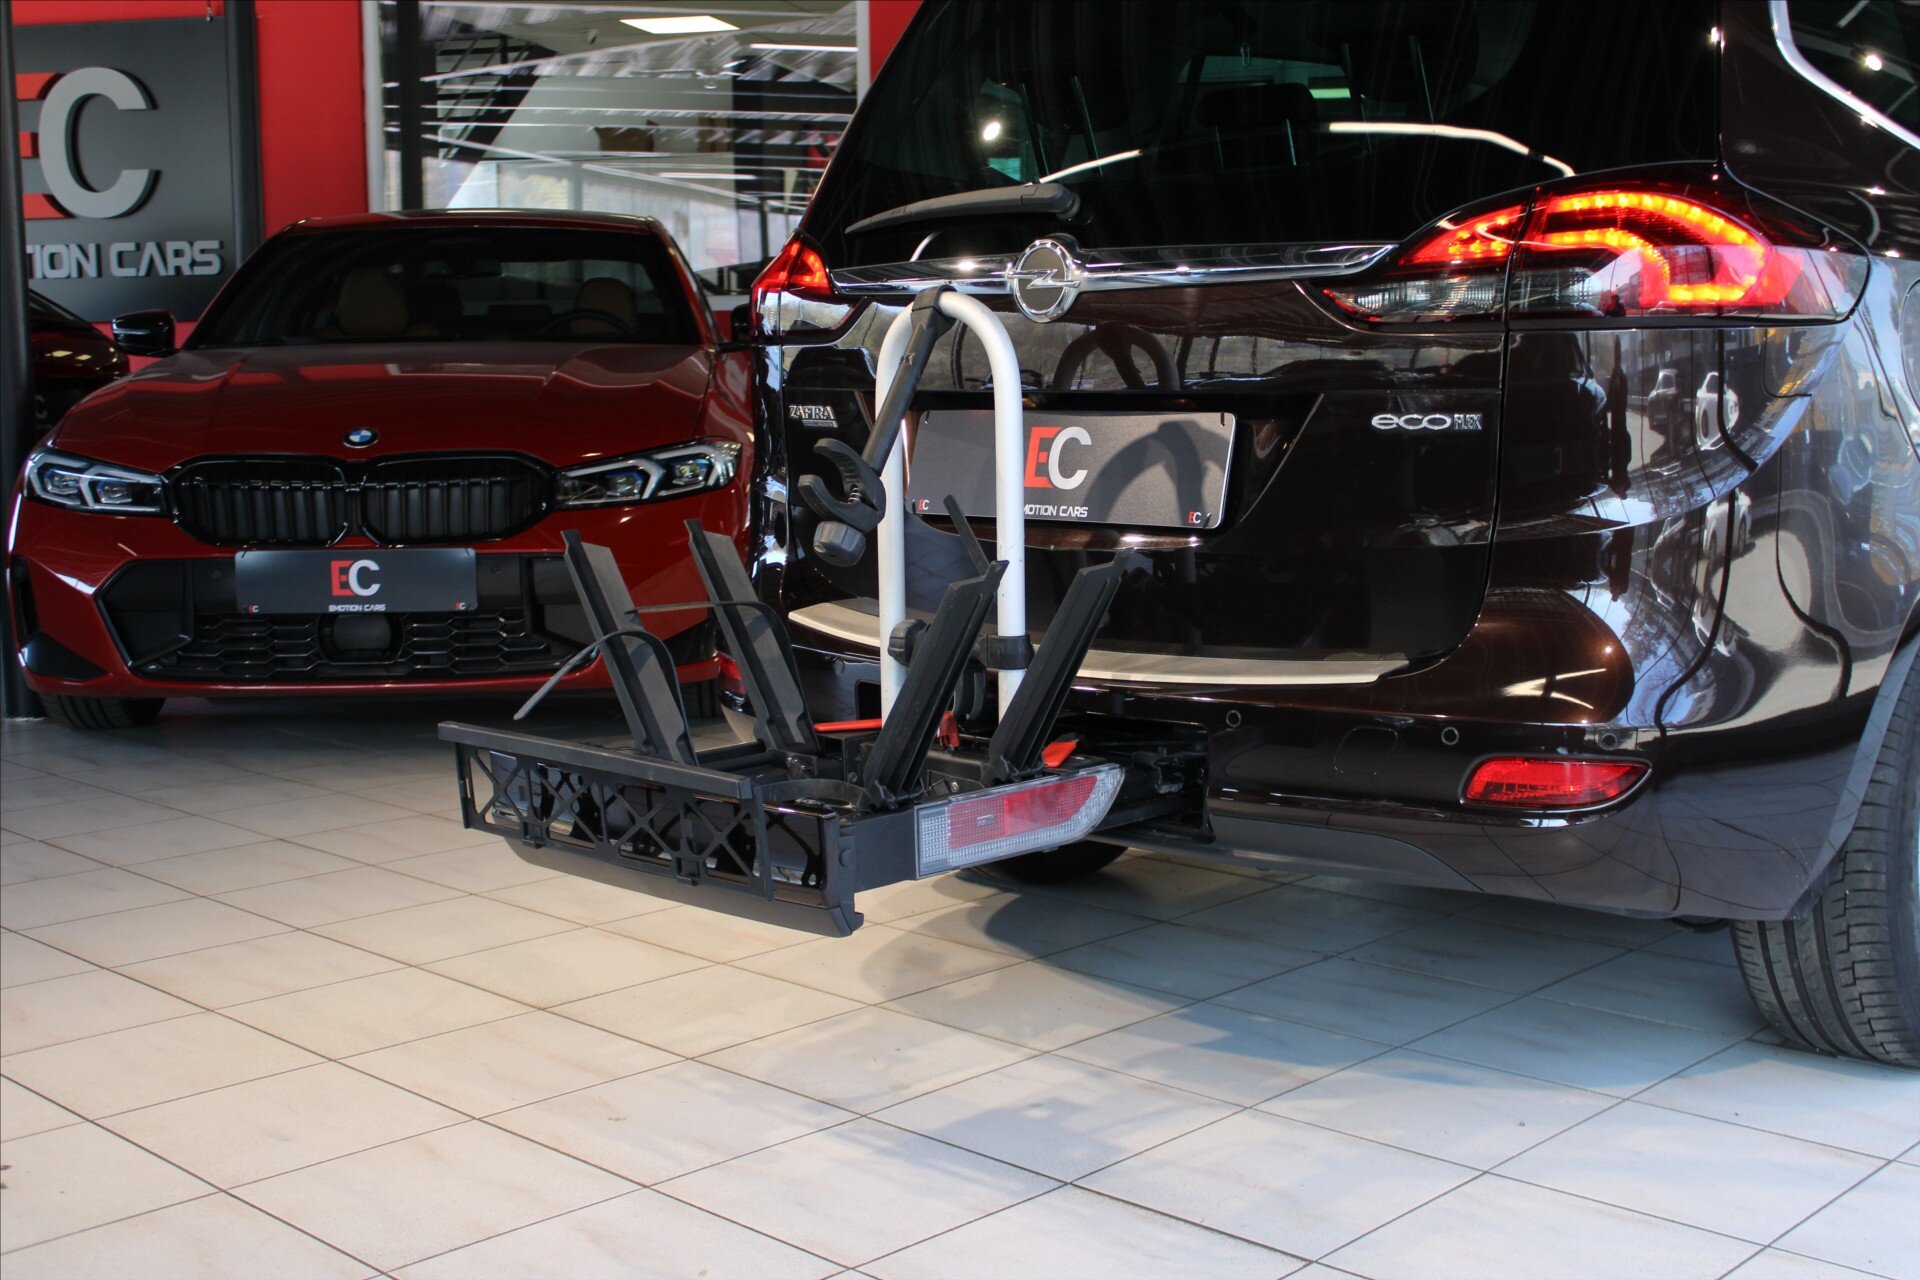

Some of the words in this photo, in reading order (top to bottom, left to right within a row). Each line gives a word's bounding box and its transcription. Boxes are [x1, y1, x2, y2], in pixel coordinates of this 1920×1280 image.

[109, 240, 221, 277] CARS
[788, 405, 835, 419] ZAFIRA
[1024, 426, 1092, 490] EC
[1059, 506, 1089, 517] CARS
[1188, 511, 1202, 524] EC
[330, 559, 381, 596] EC
[328, 604, 362, 612] EMOTION
[363, 603, 386, 612] CARS
